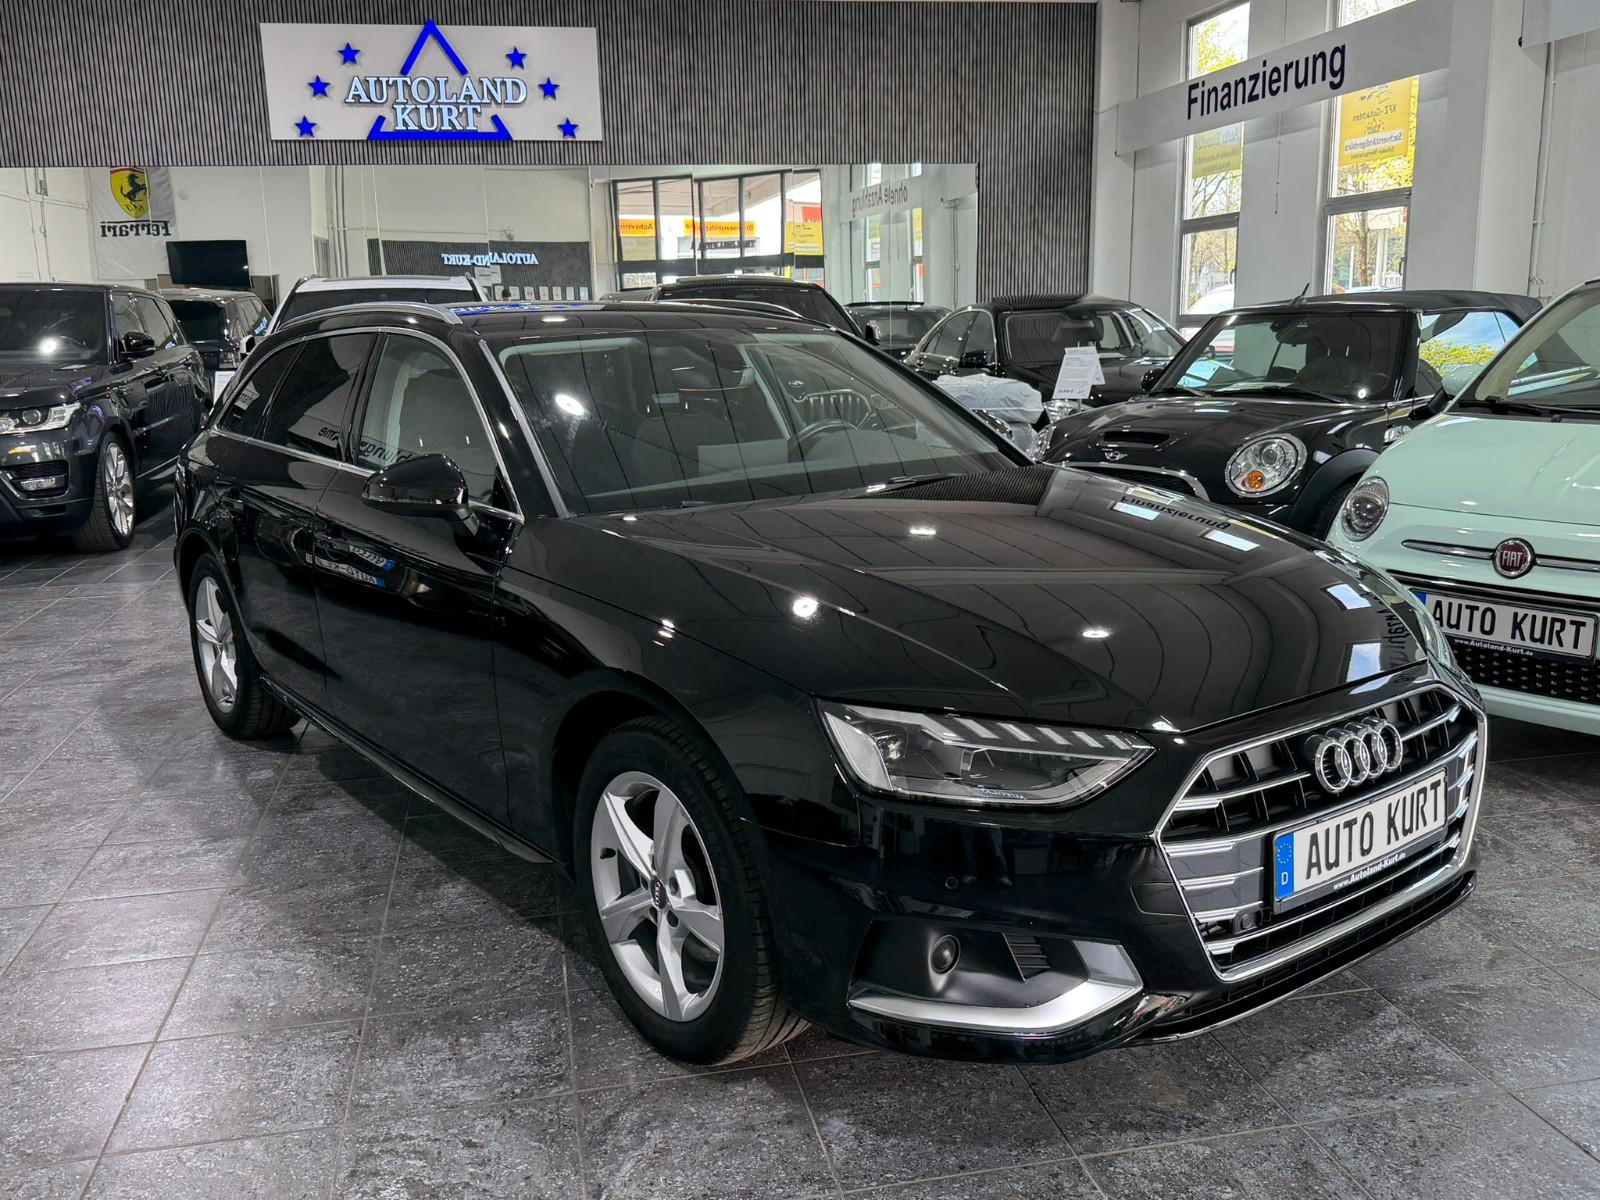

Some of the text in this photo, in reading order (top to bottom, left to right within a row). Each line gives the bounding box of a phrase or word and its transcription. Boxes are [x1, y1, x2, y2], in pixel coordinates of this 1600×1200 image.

[345, 76, 528, 105] AUTOLAND
[1187, 43, 1346, 120] Finanzierung
[393, 104, 482, 131] KURT
[1501, 550, 1523, 567] FIAT
[1432, 599, 1587, 650] AUTO KURT
[1305, 779, 1442, 881] AUTO KURT
[1281, 871, 1289, 886] D
